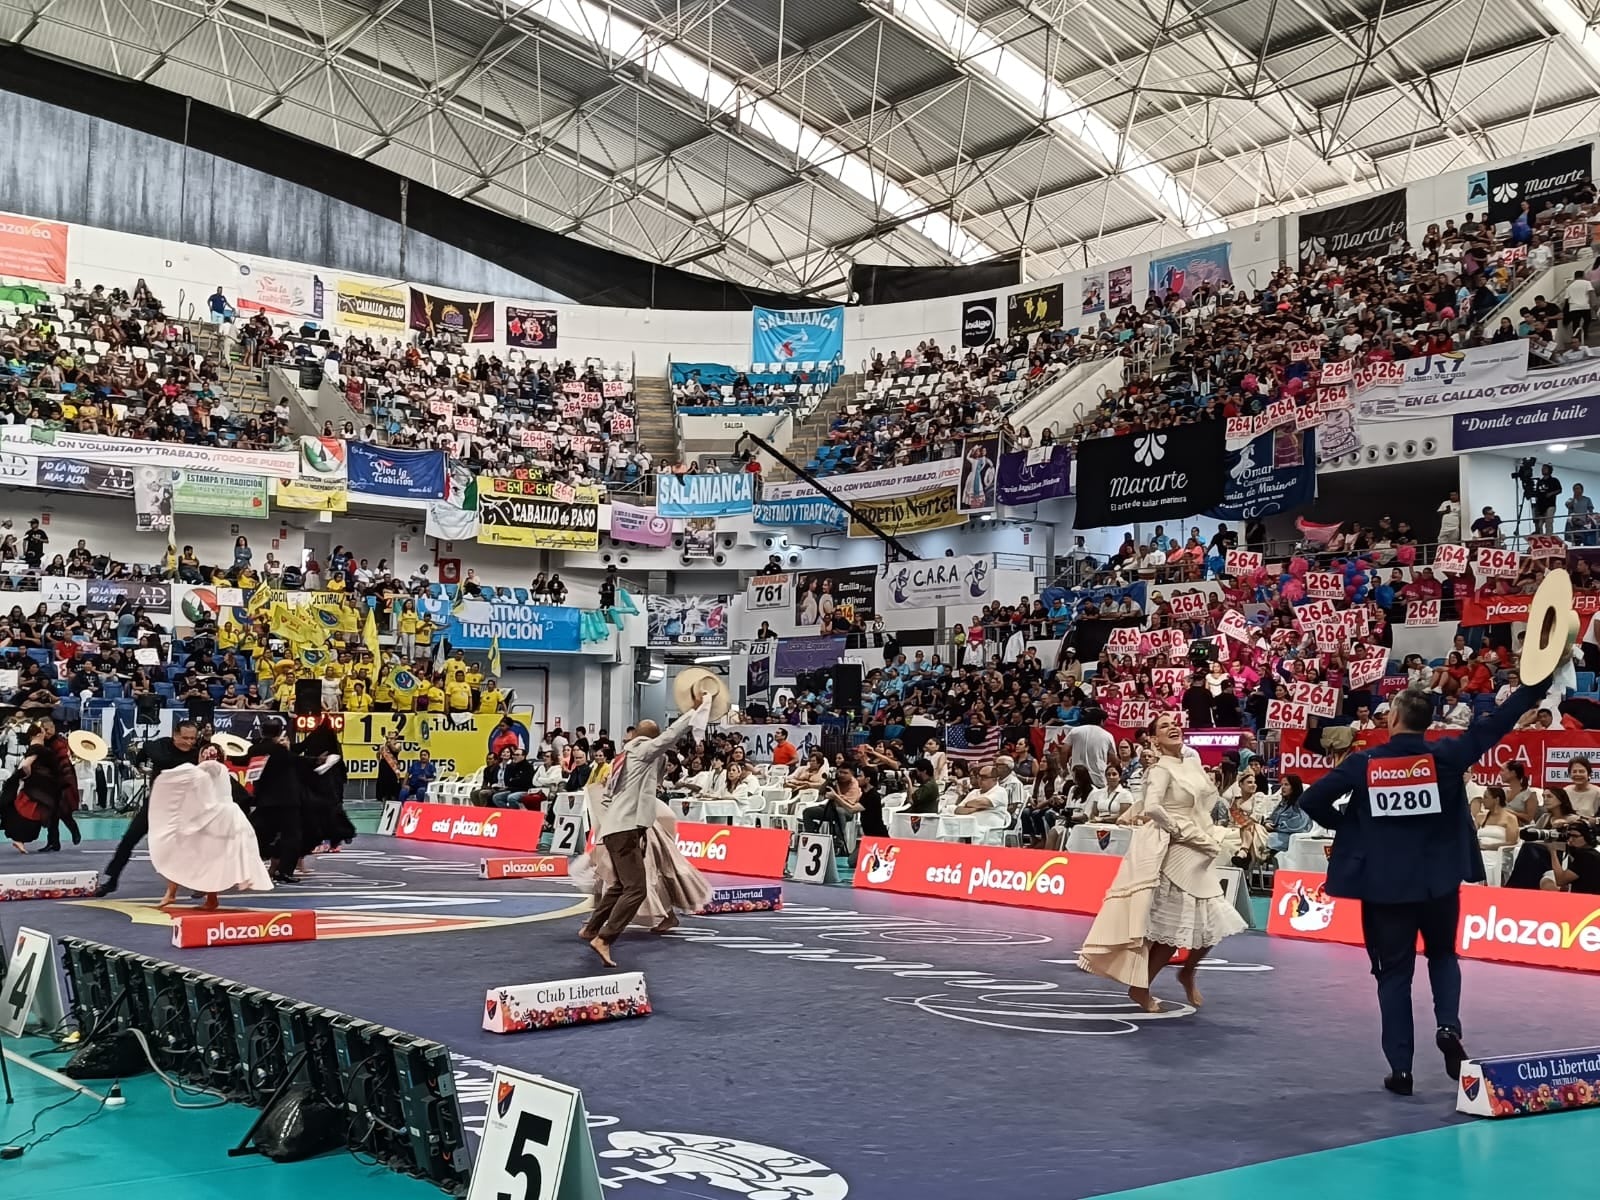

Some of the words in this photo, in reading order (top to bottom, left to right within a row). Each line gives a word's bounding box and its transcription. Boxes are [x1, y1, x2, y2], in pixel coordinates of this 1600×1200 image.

[165, 260, 173, 268] D
[758, 311, 839, 332] SALAMANCA
[1292, 340, 1318, 354] 264
[1324, 361, 1351, 377] 264
[1378, 363, 1405, 378] 264
[605, 383, 623, 393] 264
[1319, 386, 1348, 404] 264
[1405, 396, 1423, 407] EN
[1424, 395, 1440, 405] EL
[1442, 387, 1497, 403] CALLAO,
[1500, 383, 1530, 395] CON
[1533, 372, 1600, 391] VOLUNTA
[580, 394, 599, 403] 264
[564, 402, 581, 413] 264
[1270, 398, 1295, 419] 264
[1515, 409, 1549, 425] cada
[1552, 404, 1588, 421] baile
[455, 418, 475, 427] 264
[612, 419, 631, 429] 264
[724, 421, 744, 430] SALIDA
[1229, 417, 1250, 431] 264
[523, 432, 542, 442] 264
[77, 441, 143, 455] VOLUNTAD
[146, 446, 154, 454] Y
[155, 447, 210, 462] TRABAJO,
[41, 462, 54, 470] AD
[55, 462, 66, 472] LA
[67, 463, 90, 475] NOTA
[370, 459, 396, 476] Viva
[515, 468, 543, 479] 0264
[65, 474, 86, 486] ALTA
[187, 474, 219, 484] ESTAMPA
[372, 472, 414, 486] Tradición
[495, 480, 520, 492] 0264
[844, 483, 859, 492] CON
[860, 478, 896, 490] VOLUNTAD
[523, 482, 549, 494] 0264
[660, 473, 752, 505] SALAMANCA
[1117, 502, 1132, 511] arte
[1132, 499, 1141, 507] de
[150, 515, 172, 526] 249
[512, 503, 560, 525] CABALLO
[560, 511, 569, 525] de
[571, 509, 596, 528] PASO
[1530, 536, 1563, 549] 264
[1228, 552, 1260, 568] 264
[1436, 546, 1465, 563] 264
[1479, 549, 1517, 568] 264
[839, 583, 860, 592] Emilia
[1309, 573, 1342, 591] 264
[88, 586, 100, 594] AD
[101, 587, 109, 595] LA
[109, 587, 129, 596] NOTA
[755, 585, 783, 603] 761
[846, 596, 866, 605] Oliver
[1172, 595, 1204, 613] 264
[489, 605, 532, 622] RITMO
[1297, 601, 1333, 624] 264
[1408, 601, 1438, 618] 264
[1486, 602, 1528, 620] plaza
[1110, 630, 1138, 646] 264
[1317, 624, 1347, 643] 264
[751, 643, 769, 654] 761
[1352, 658, 1383, 679] 264
[1383, 677, 1407, 686] PISTA
[1297, 684, 1335, 706] 264
[1122, 703, 1146, 720] 264
[1268, 701, 1305, 723] 264
[1314, 705, 1335, 717] CARLOS
[1551, 751, 1571, 760] HEXA
[1370, 759, 1431, 785] plazavea
[1551, 770, 1561, 779] DE
[1376, 789, 1432, 812] 0280
[385, 808, 394, 831] 1
[431, 819, 450, 834] está
[450, 812, 502, 839] plazavea
[558, 822, 576, 850] 2
[502, 856, 555, 877] plazavea
[805, 843, 823, 876] 3
[15, 876, 37, 886] Club
[39, 875, 77, 886] Libertad
[926, 863, 962, 885] está
[967, 857, 1068, 896] plazavea
[712, 890, 731, 902] Club
[731, 888, 763, 900] Libertad
[207, 912, 293, 946] plazavea
[9, 951, 37, 1021] 4
[536, 987, 566, 1005] Club
[569, 981, 620, 1000] Libertad
[1517, 1061, 1549, 1081] Club
[496, 1110, 552, 1200] 5
